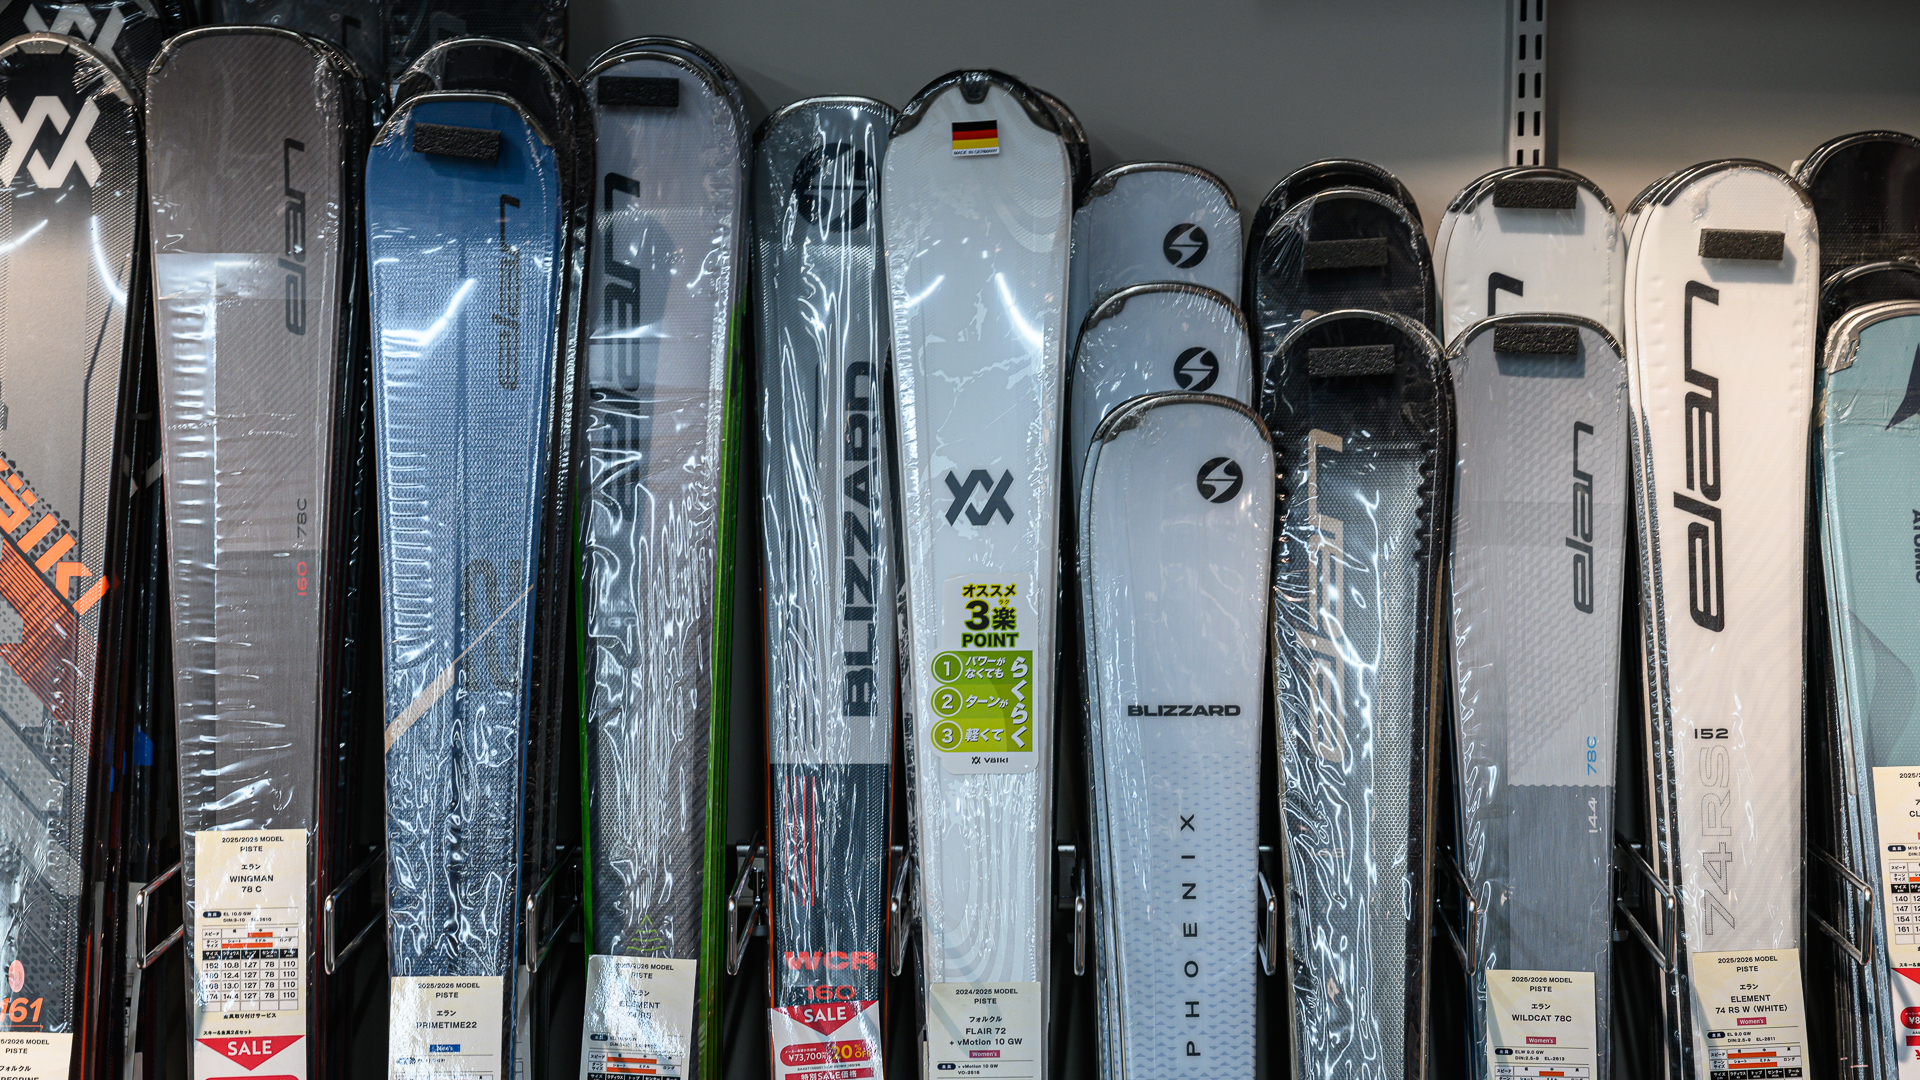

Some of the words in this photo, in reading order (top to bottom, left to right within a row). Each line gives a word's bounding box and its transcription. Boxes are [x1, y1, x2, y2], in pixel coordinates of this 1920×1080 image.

[278, 138, 306, 335] elan
[1674, 280, 1725, 632] elan
[297, 498, 307, 538] 78C
[1566, 421, 1594, 614] elan
[843, 361, 880, 717] BLIZZARD
[297, 561, 307, 596] 160
[962, 584, 1016, 598] オススメ
[965, 600, 1015, 630] 3楽
[962, 634, 1018, 647] POINT
[944, 662, 951, 676] 1
[965, 656, 1006, 667] パワーが
[965, 668, 1004, 679] なくても
[941, 694, 954, 709] 2
[965, 695, 1009, 708] ターンが
[1128, 705, 1241, 717] BLIZZARD
[941, 729, 954, 743] 3
[965, 729, 1004, 742] 軽くて
[1694, 728, 1729, 740] 152
[1587, 736, 1597, 776] 78C
[229, 875, 274, 883] WINGMAN
[1180, 814, 1201, 1056] PHOENIX
[784, 951, 876, 970] WCR
[805, 985, 856, 1000] 160
[804, 1007, 846, 1022] SALE
[1753, 1004, 1788, 1012] (WHITE)
[227, 1040, 272, 1056] SALE
[831, 1045, 852, 1060] 20
[788, 1052, 822, 1062] ¥73,700
